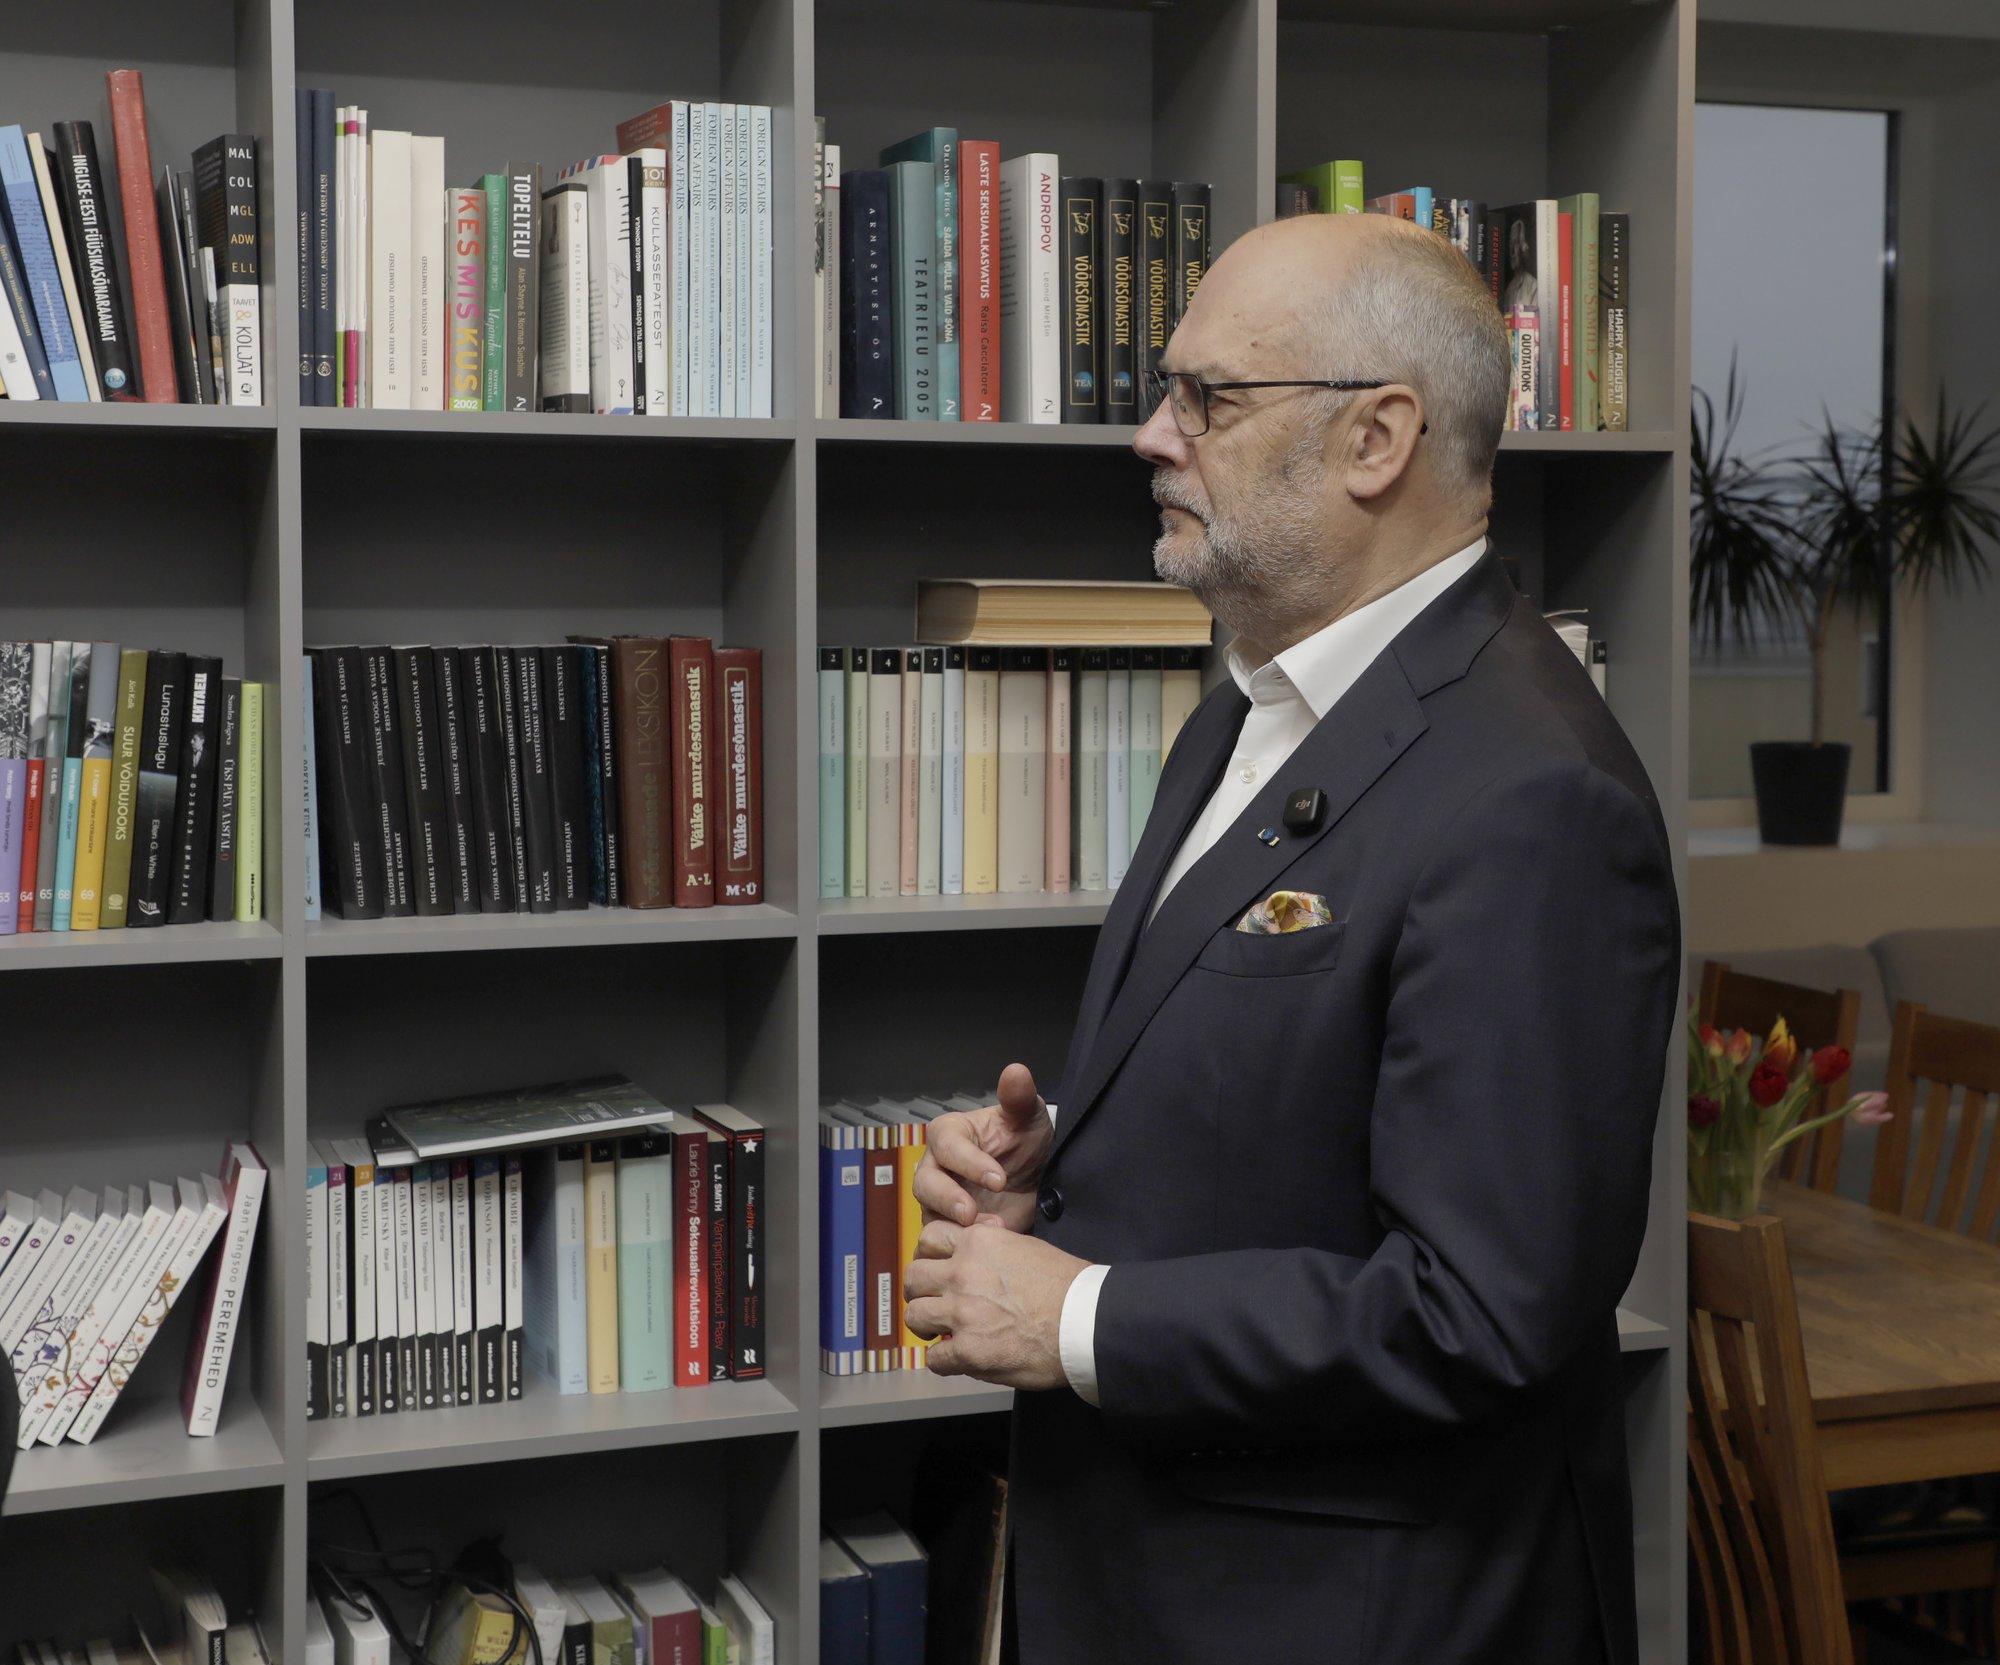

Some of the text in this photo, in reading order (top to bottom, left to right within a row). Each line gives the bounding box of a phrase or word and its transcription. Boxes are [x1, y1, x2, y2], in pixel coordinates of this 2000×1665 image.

[229, 147, 253, 160] MAL
[675, 112, 685, 210] FOREIGN AFFAIRS
[692, 110, 702, 207] FOREIGN AFFAIRS
[707, 114, 717, 211] FOREIGN AFFAIRS
[724, 118, 733, 214] FOREIGN AFFAIRS
[738, 118, 748, 215] FOREIGN AFFAIRS
[757, 117, 767, 215] FOREIGN AFFAIRS
[943, 144, 951, 188] ORLANDO
[230, 176, 254, 188] COL
[230, 205, 255, 216] MGL
[512, 174, 532, 258] TOPELTELU
[72, 155, 117, 342] INGLISE-EESTI FÜÜSIKASÕNARAAMAT
[230, 234, 255, 245] ADW
[869, 208, 878, 321] ARMASTUSE
[942, 226, 953, 259] SAADA
[1040, 172, 1052, 337] ANDROPOV Leonid Mletšin
[232, 263, 256, 273] ELL
[454, 195, 481, 392] KES MIS KUS
[517, 267, 526, 282] Alan
[651, 206, 663, 349] KULLASSEPATEOST
[943, 261, 953, 291] MULLE
[980, 152, 990, 395] LASTE SEKSUAALKASVATUS Raisa Cacciatore
[234, 310, 254, 321] &
[515, 284, 526, 310] Shayne
[944, 293, 953, 315] VAID
[1074, 255, 1092, 345] VÕÕRSÕNASTIK
[1114, 255, 1132, 345] VÕÕRSÕNASTIK
[1150, 258, 1168, 347] VÕÕRSÕNASTIK
[236, 326, 255, 376] KOLJAT
[486, 307, 502, 358] Majandus
[517, 317, 526, 344] Norman
[915, 258, 929, 413] TEATRIELU 2005
[944, 317, 955, 342] SÕNA
[1615, 308, 1624, 404] HARRY AUGUSTI
[517, 346, 525, 377] Sunshine
[1520, 333, 1532, 392] QUOTATIONS
[454, 400, 478, 410] 2002
[191, 672, 207, 723] КИТАЕЦ
[520, 657, 532, 743] VAATLUSI MAAILMALE
[529, 656, 538, 711] SEISUKOHALT
[634, 649, 661, 766] LEKSIKON
[155, 684, 173, 769] Lunastuslugu
[115, 726, 135, 840] SUUR VÕIDUJOOKS
[224, 758, 236, 781] ÜKS
[337, 657, 365, 907] GILLES DELEUZE ERINEVUS JA KORDUS
[368, 657, 396, 906] MAGDEBURGI MECHTHILD JUMALUSE VOOGAV VALGUS
[378, 656, 407, 905] MEISTER ECKHART ERISTAMISE KÕNED
[410, 655, 438, 904] MICHAEL DUMMETT METAFÜÜSIKA LOOGILINE ALUS
[443, 657, 470, 902] NIKOLAI BERDJAJEV INIMESE ORJUSEST JA VABADUSEST
[474, 656, 500, 901] THOMAS CARLYLE MINEVIK JA OLEVIK
[501, 655, 527, 903] RENÉ DESCARTES MEDITATSIOONID ESIMESEST FILOSOOFIAST
[557, 655, 574, 899] NIKOLAI BERDJAJEV ENESETUNNETUS
[599, 655, 617, 899] GILLES DELEUZE KANTI KRIITILINE FILOSOOFIA
[686, 667, 704, 850] Väike murdesõnastik
[729, 680, 747, 860] Väike murdesõnastik
[223, 783, 234, 808] PÄEV
[150, 819, 160, 839] Ellen
[221, 812, 231, 851] AASTAL
[147, 855, 157, 879] White
[542, 871, 551, 902] PLANCK
[686, 874, 712, 887] A-L
[334, 1191, 342, 1225] JAMES
[360, 1190, 369, 1239] RENDELL
[381, 1188, 389, 1241] PARETSKY
[399, 1186, 408, 1236] GRANGER
[418, 1186, 428, 1236] LEONARD
[436, 1185, 444, 1204] TEY
[456, 1182, 465, 1219] DOYLE
[484, 1180, 492, 1233] ROBINSON
[510, 1179, 518, 1227] CROMBIE
[685, 1143, 701, 1349] Laurie Penny Seksuaalrevolutsioon
[712, 1164, 726, 1350] L. J. SMITH Vampiiripäevikud: Raev
[205, 1193, 256, 1388] Jaan Tangsoo PEREMEHED
[846, 1258, 856, 1293] Nikolai
[880, 1276, 890, 1332] Jakob Hurt
